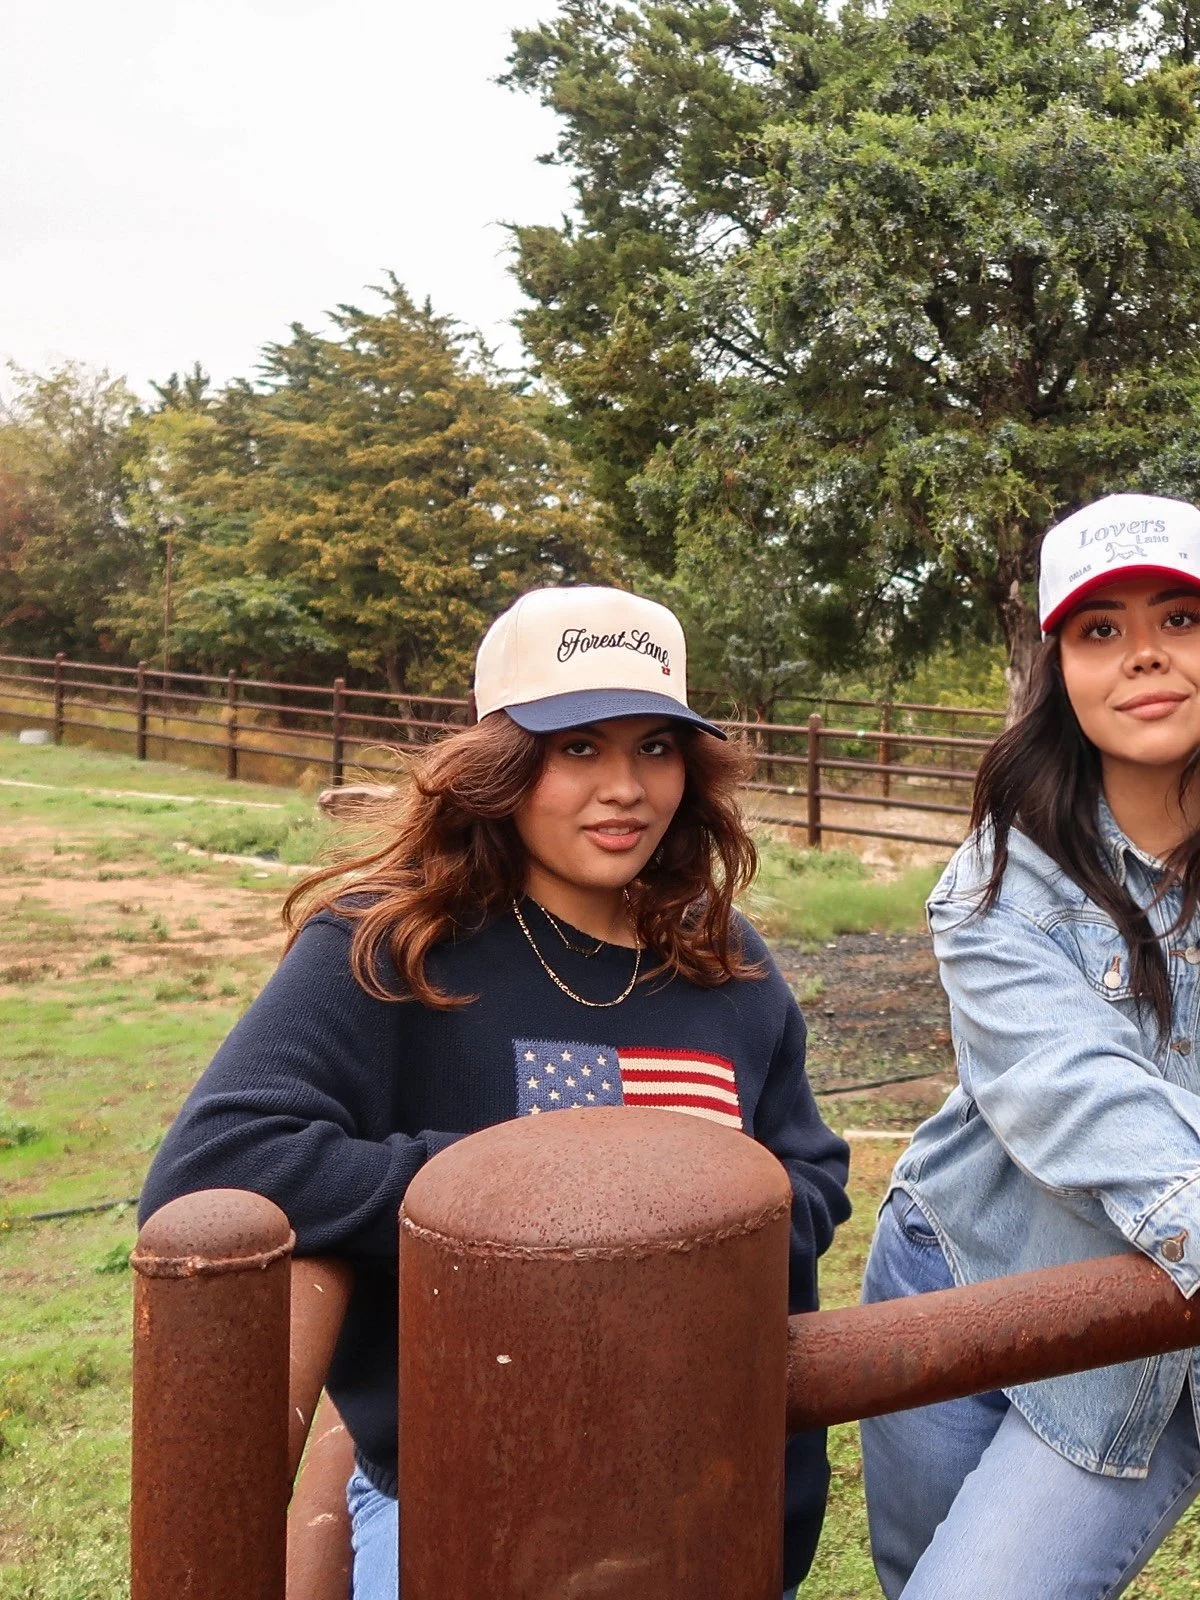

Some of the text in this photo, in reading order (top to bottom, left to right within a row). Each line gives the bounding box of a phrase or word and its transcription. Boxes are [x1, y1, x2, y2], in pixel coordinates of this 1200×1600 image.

[1078, 519, 1166, 549] Lovers
[1135, 534, 1169, 545] Lane
[1068, 552, 1188, 582] DALLAS TX
[557, 628, 670, 667] Forest Lane
